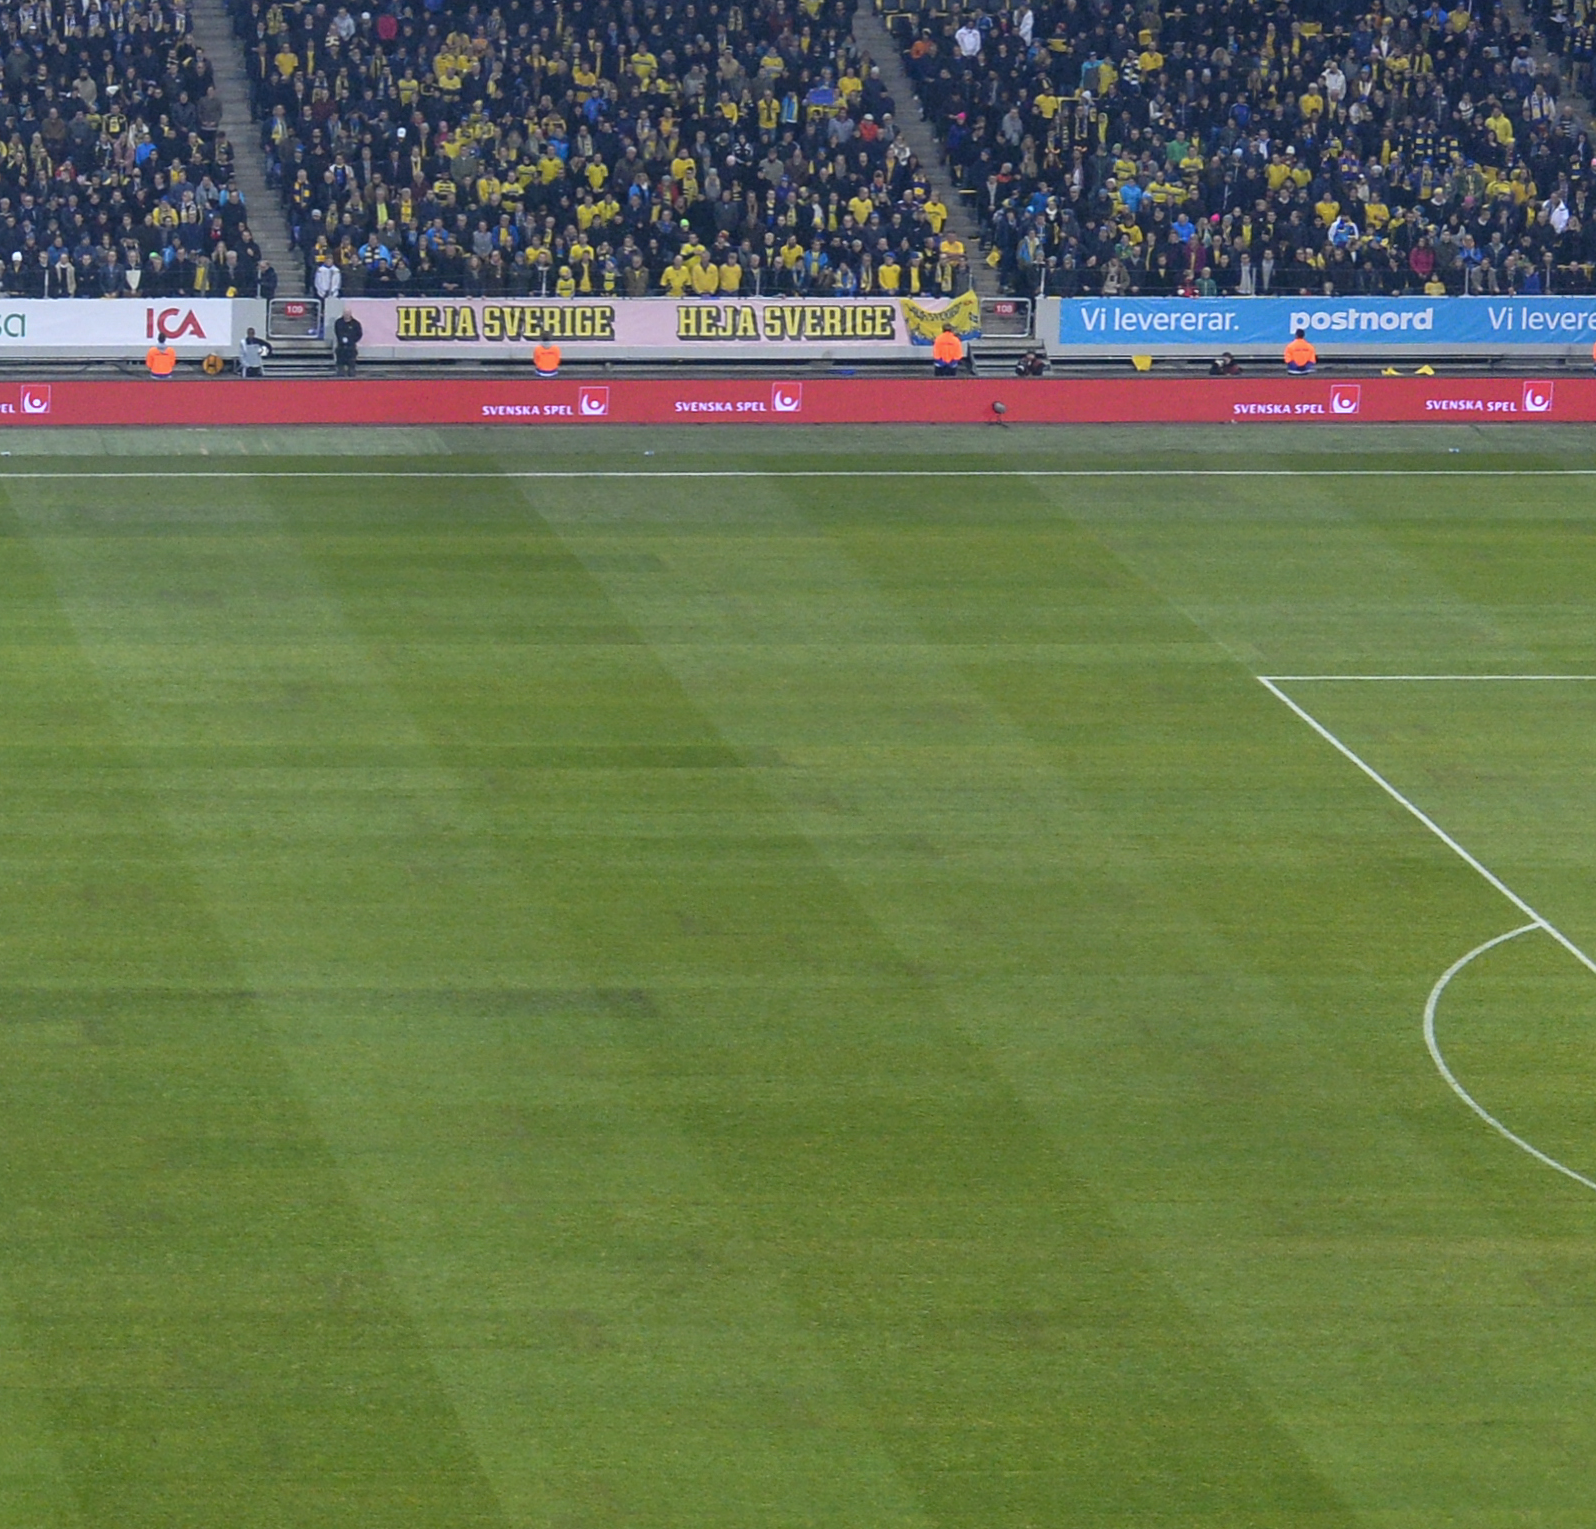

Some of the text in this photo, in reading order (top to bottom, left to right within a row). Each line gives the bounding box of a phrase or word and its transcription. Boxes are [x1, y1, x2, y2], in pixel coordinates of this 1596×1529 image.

[287, 305, 303, 315] 109
[997, 304, 1013, 314] 108
[1487, 306, 1513, 330] Vi
[146, 308, 207, 339] ICA
[396, 305, 615, 341] HEJA SVERIGE
[676, 305, 758, 340] HEJA
[763, 305, 896, 340] SVERIGE
[1081, 307, 1239, 331] Vi levererar.
[1289, 306, 1433, 334] postnord
[481, 405, 574, 416] SVENSKA SPEL
[675, 401, 767, 412] SVENSKA SPEL
[1233, 403, 1325, 414] SVENSKA SPEL
[1425, 400, 1517, 412] SVENSKA SPEL
